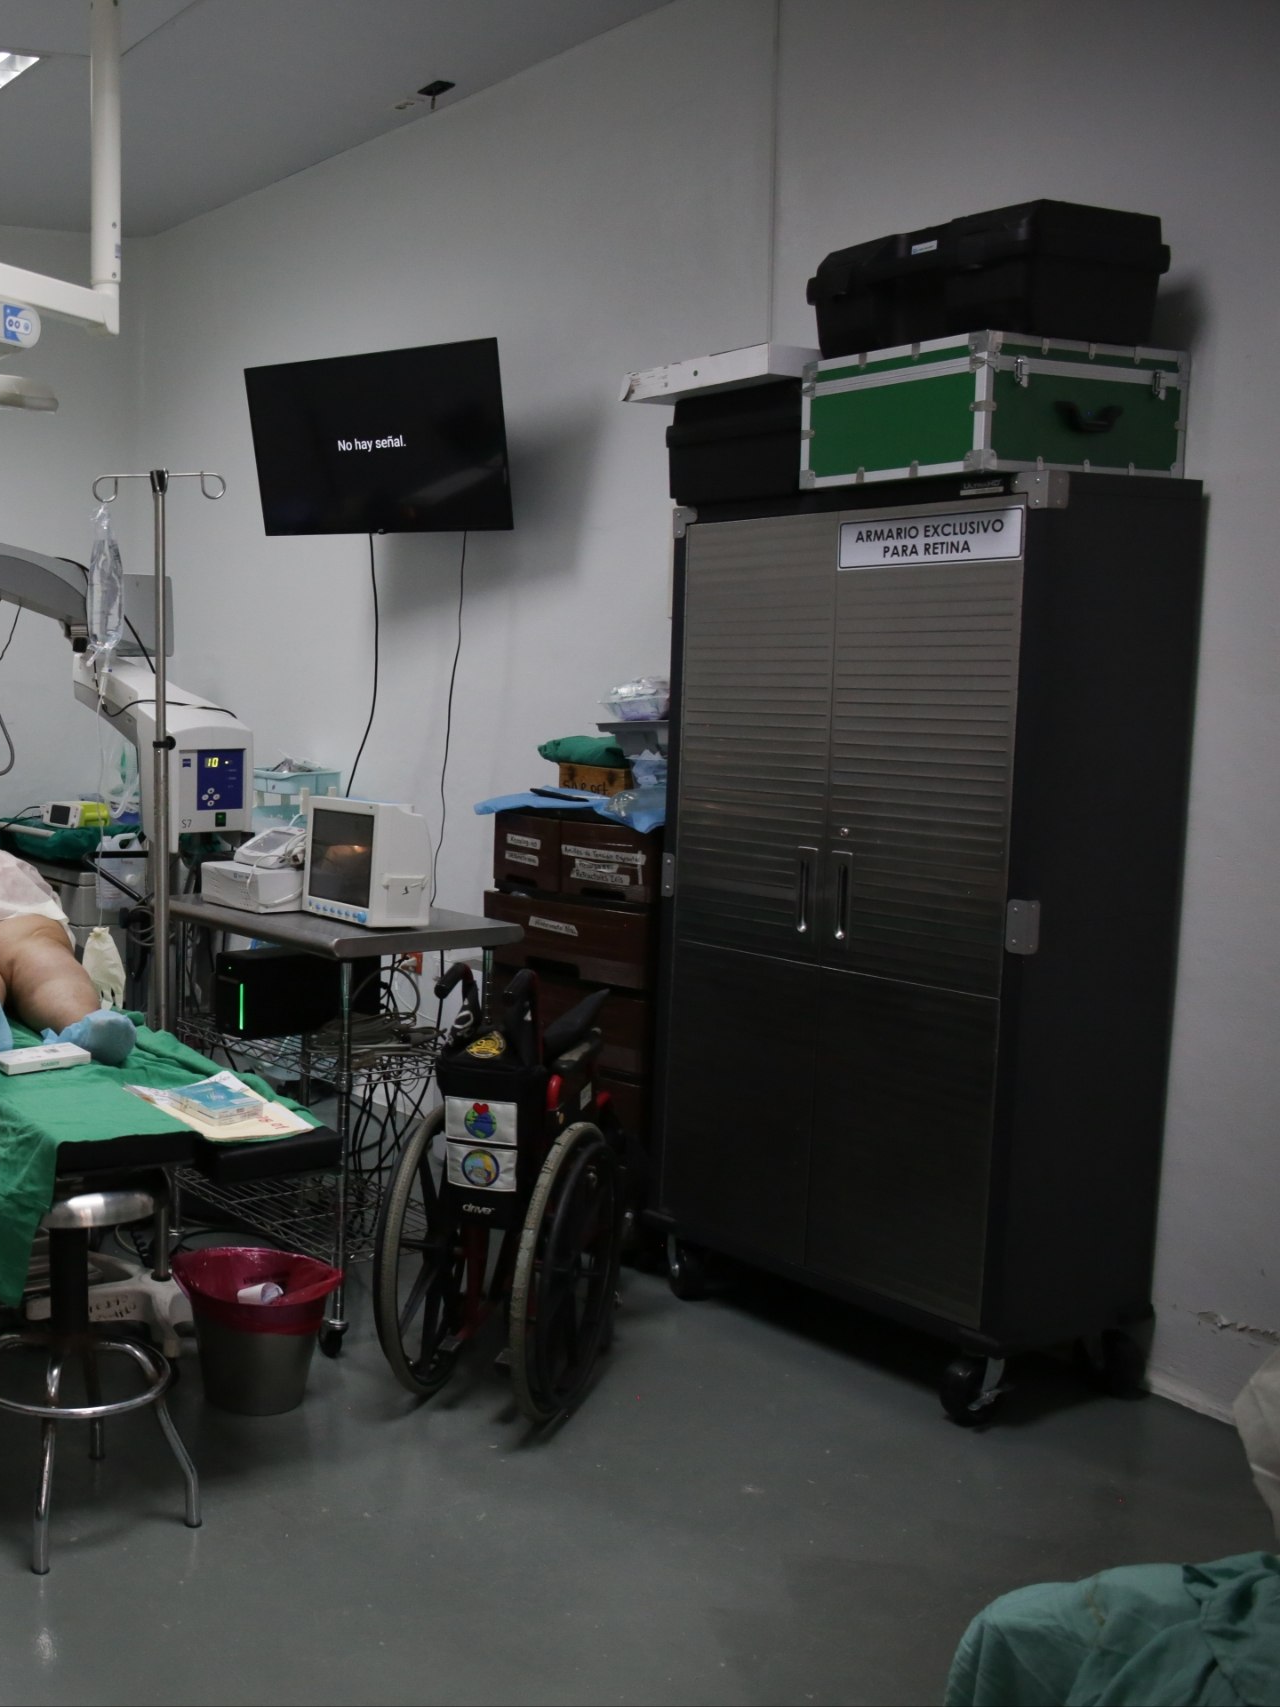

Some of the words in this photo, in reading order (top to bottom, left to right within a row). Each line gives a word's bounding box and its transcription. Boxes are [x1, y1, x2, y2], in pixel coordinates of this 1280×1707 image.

[337, 439, 352, 451] No
[354, 438, 373, 452] hay
[375, 434, 406, 449] señal.
[855, 526, 919, 543] ARMARIO
[924, 518, 1004, 539] EXCLUSIVO
[883, 544, 919, 558] PARA
[924, 540, 971, 556] RETINA
[207, 757, 219, 768] 10
[462, 1203, 493, 1215] drive
